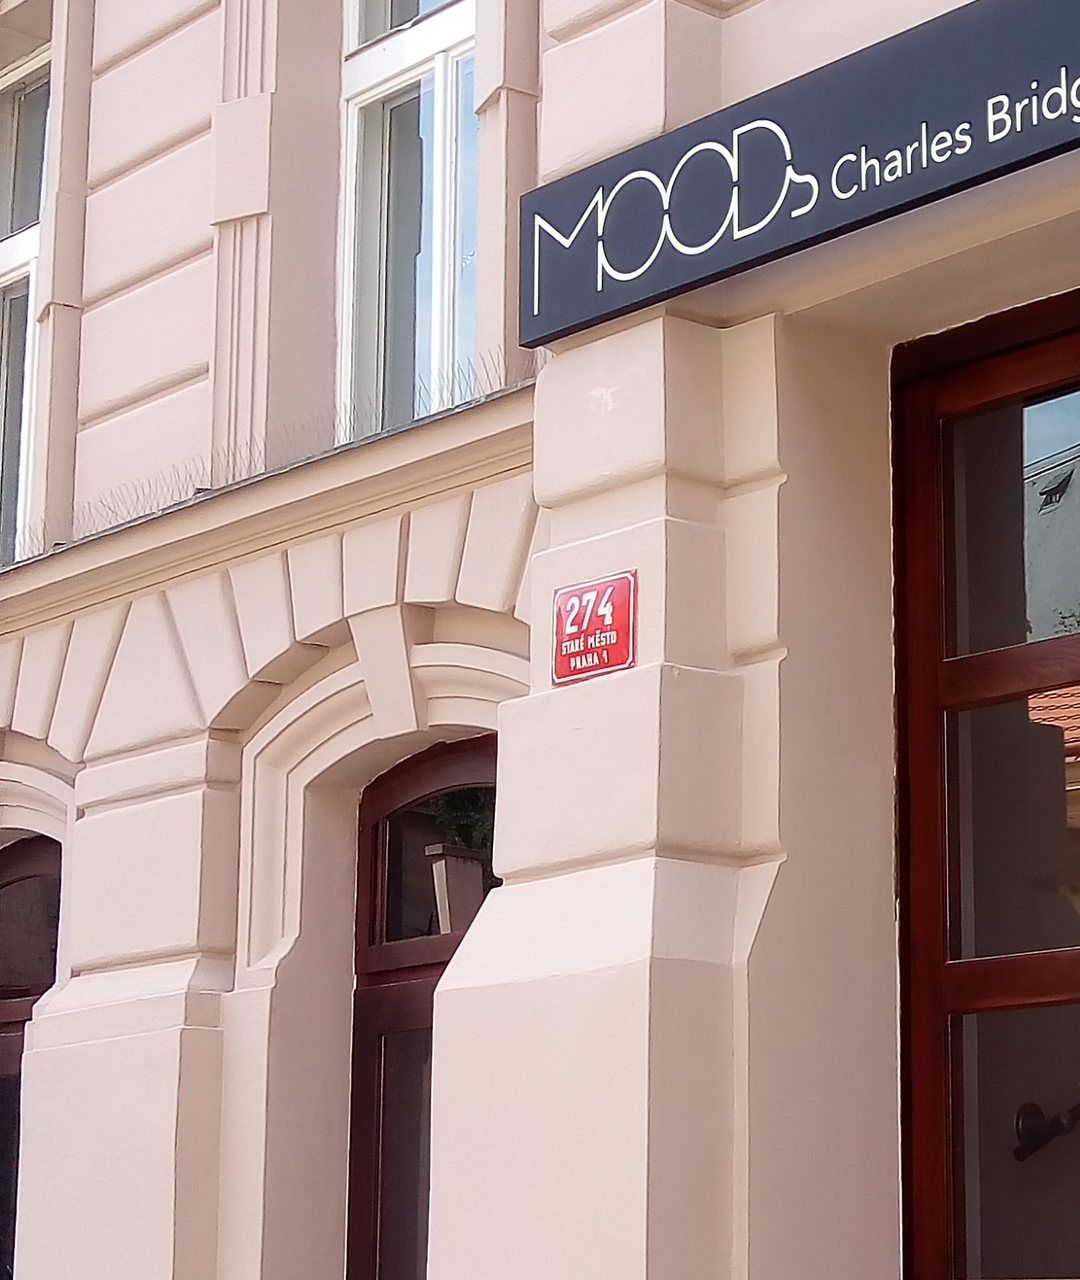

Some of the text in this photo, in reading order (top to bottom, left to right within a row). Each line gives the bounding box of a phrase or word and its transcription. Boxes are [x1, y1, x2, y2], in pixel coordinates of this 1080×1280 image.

[831, 122, 972, 200] Charles
[564, 586, 615, 635] 274
[561, 630, 617, 655] STARÉ MĚSTO
[570, 650, 608, 671] PRAHA 1
